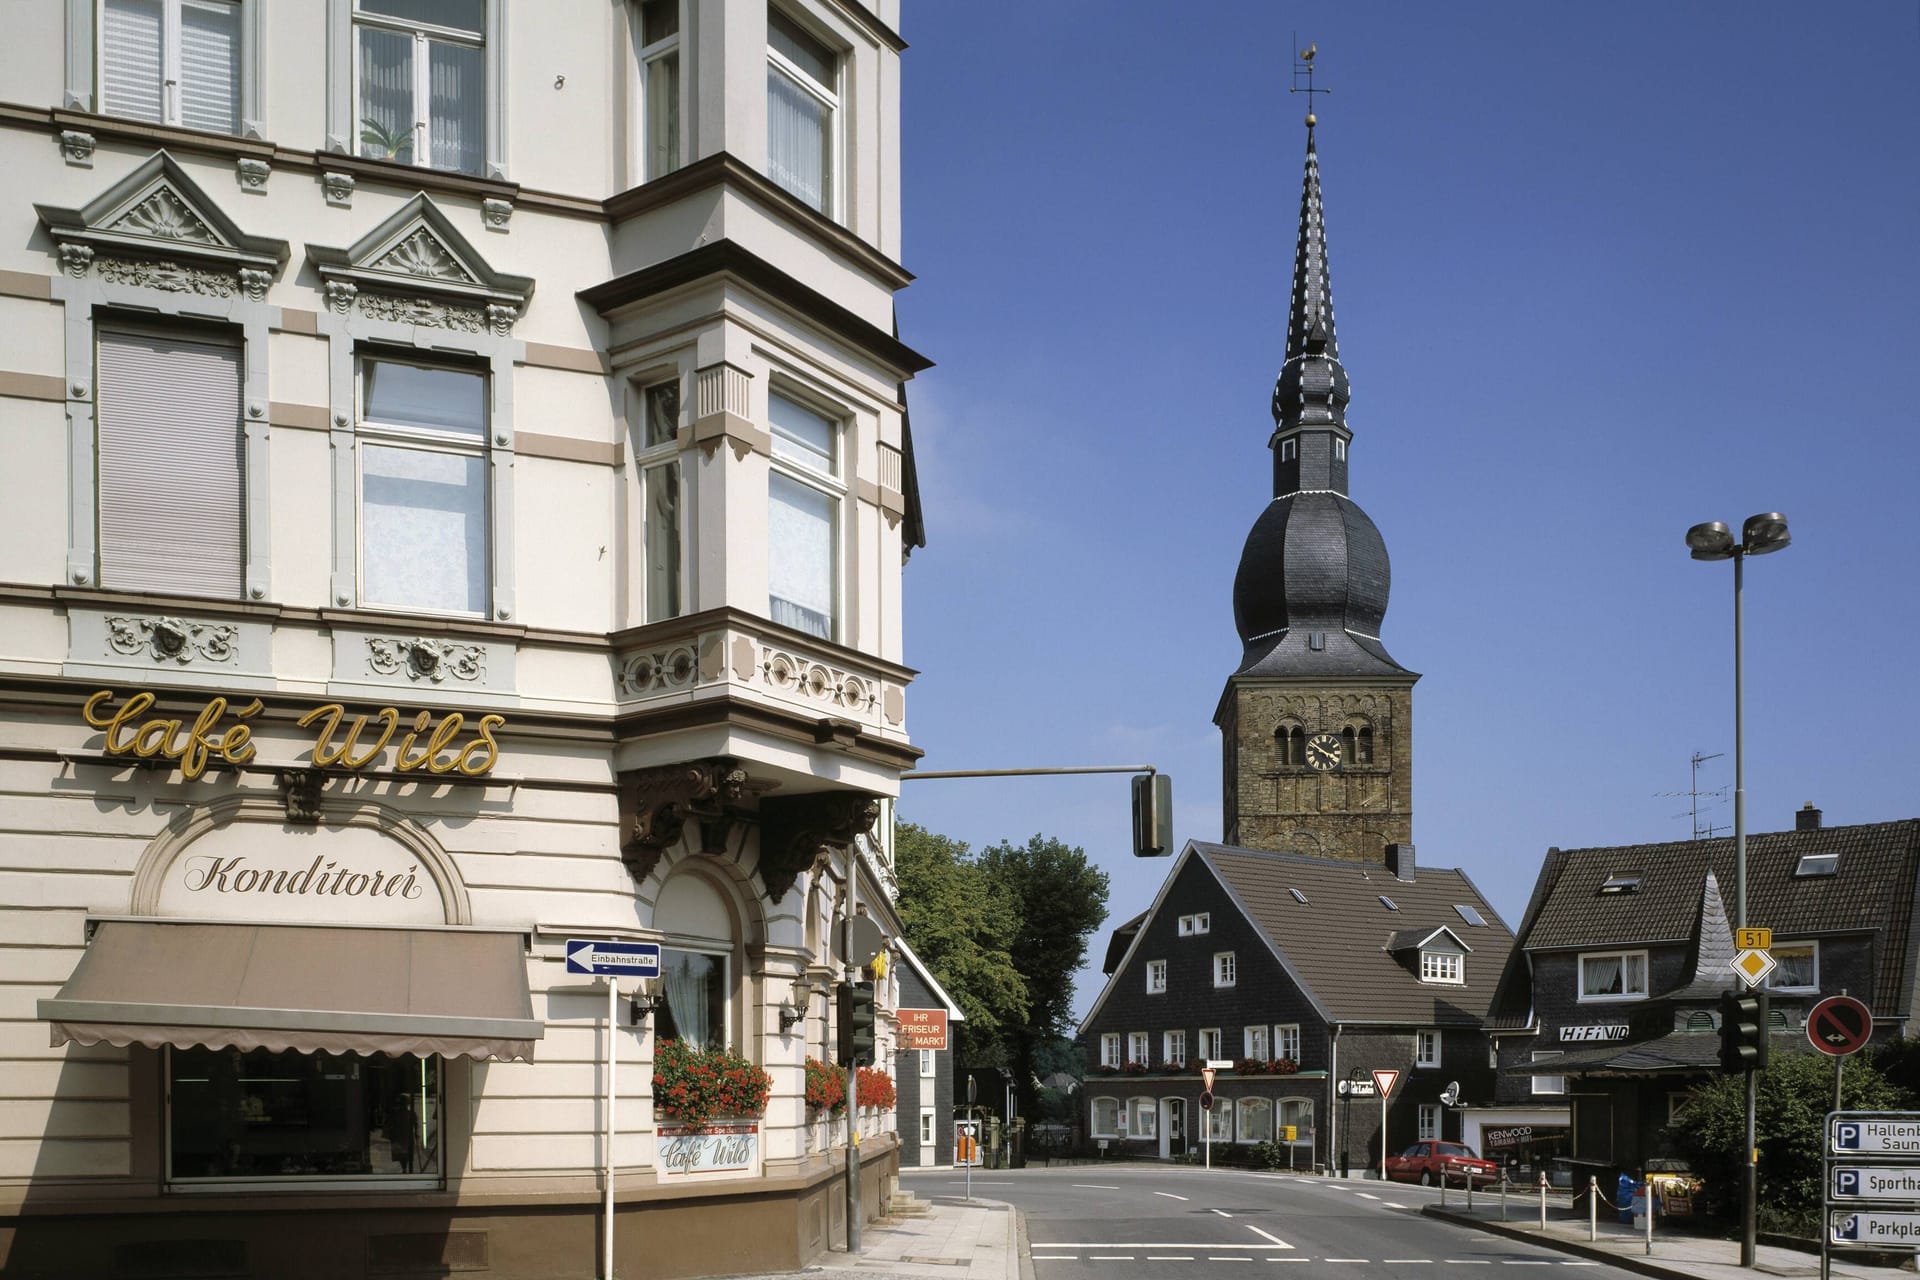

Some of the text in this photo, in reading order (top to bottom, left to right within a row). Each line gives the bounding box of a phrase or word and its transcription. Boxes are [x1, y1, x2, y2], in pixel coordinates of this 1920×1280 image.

[82, 689, 506, 781] Café Wild
[184, 855, 423, 900] Konditorei
[1746, 932, 1761, 945] 51
[591, 954, 654, 965] Einbahnstraße
[913, 1013, 928, 1021] IHR
[901, 1024, 940, 1034] FRISEUR
[915, 1036, 945, 1046] MARKT
[1487, 1126, 1532, 1141] KENWOOD
[1882, 1137, 1920, 1150] Saun
[660, 1136, 756, 1175] Café Wild
[1869, 1220, 1920, 1239] Parkpla
